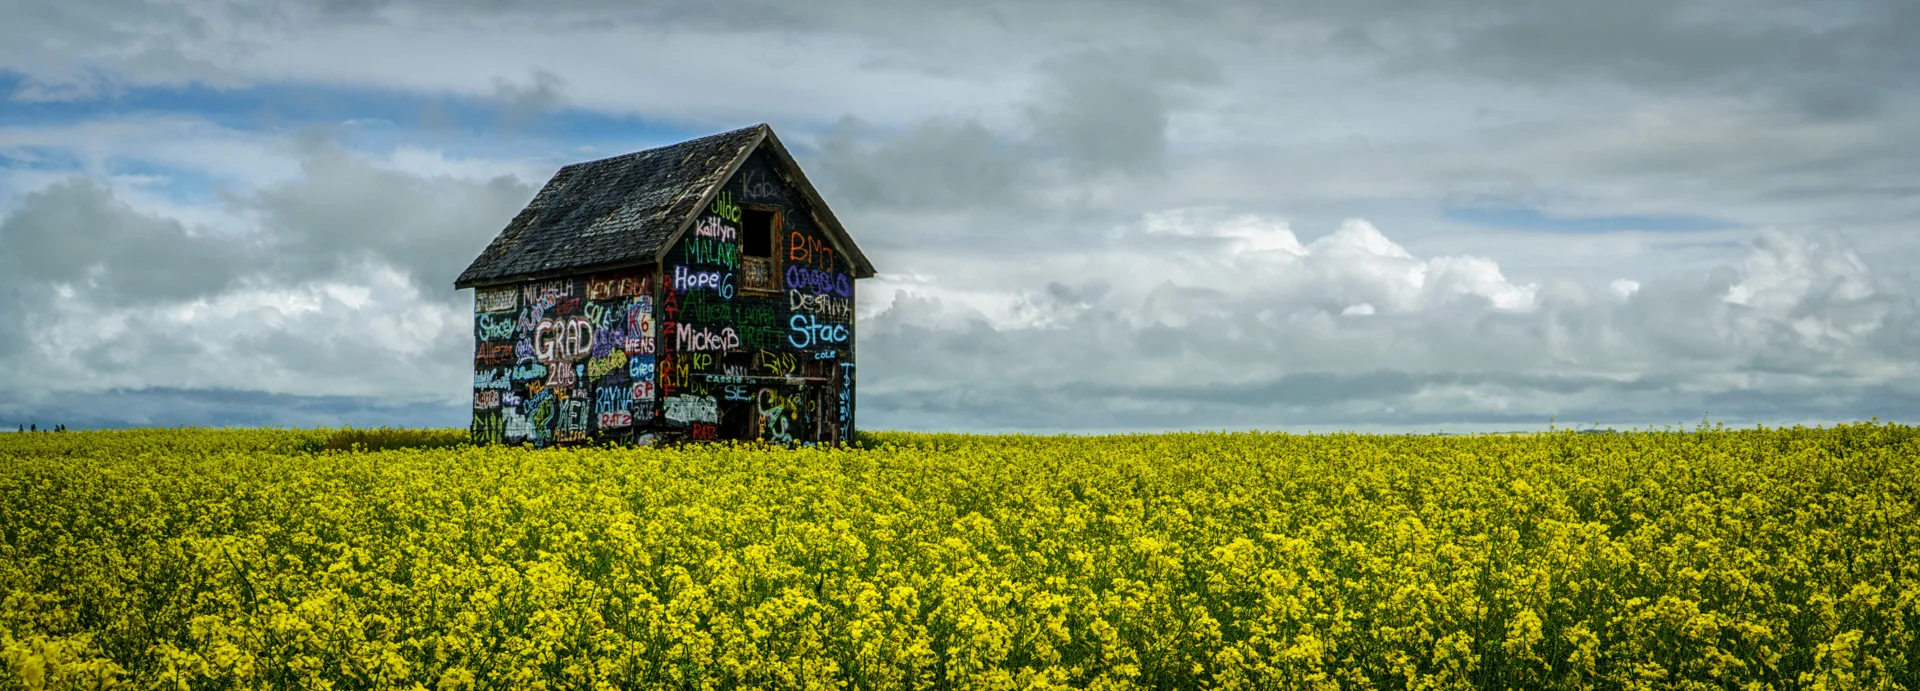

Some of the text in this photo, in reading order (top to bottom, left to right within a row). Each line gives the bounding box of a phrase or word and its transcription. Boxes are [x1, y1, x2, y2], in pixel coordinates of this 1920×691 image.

[695, 216, 736, 243] Kaitlyn
[674, 265, 720, 291] Hope
[523, 278, 574, 308] MICHAELA
[535, 317, 594, 362] GRAD
[693, 352, 712, 371] KP
[814, 351, 836, 360] COLE
[595, 385, 634, 414] RAYNA
